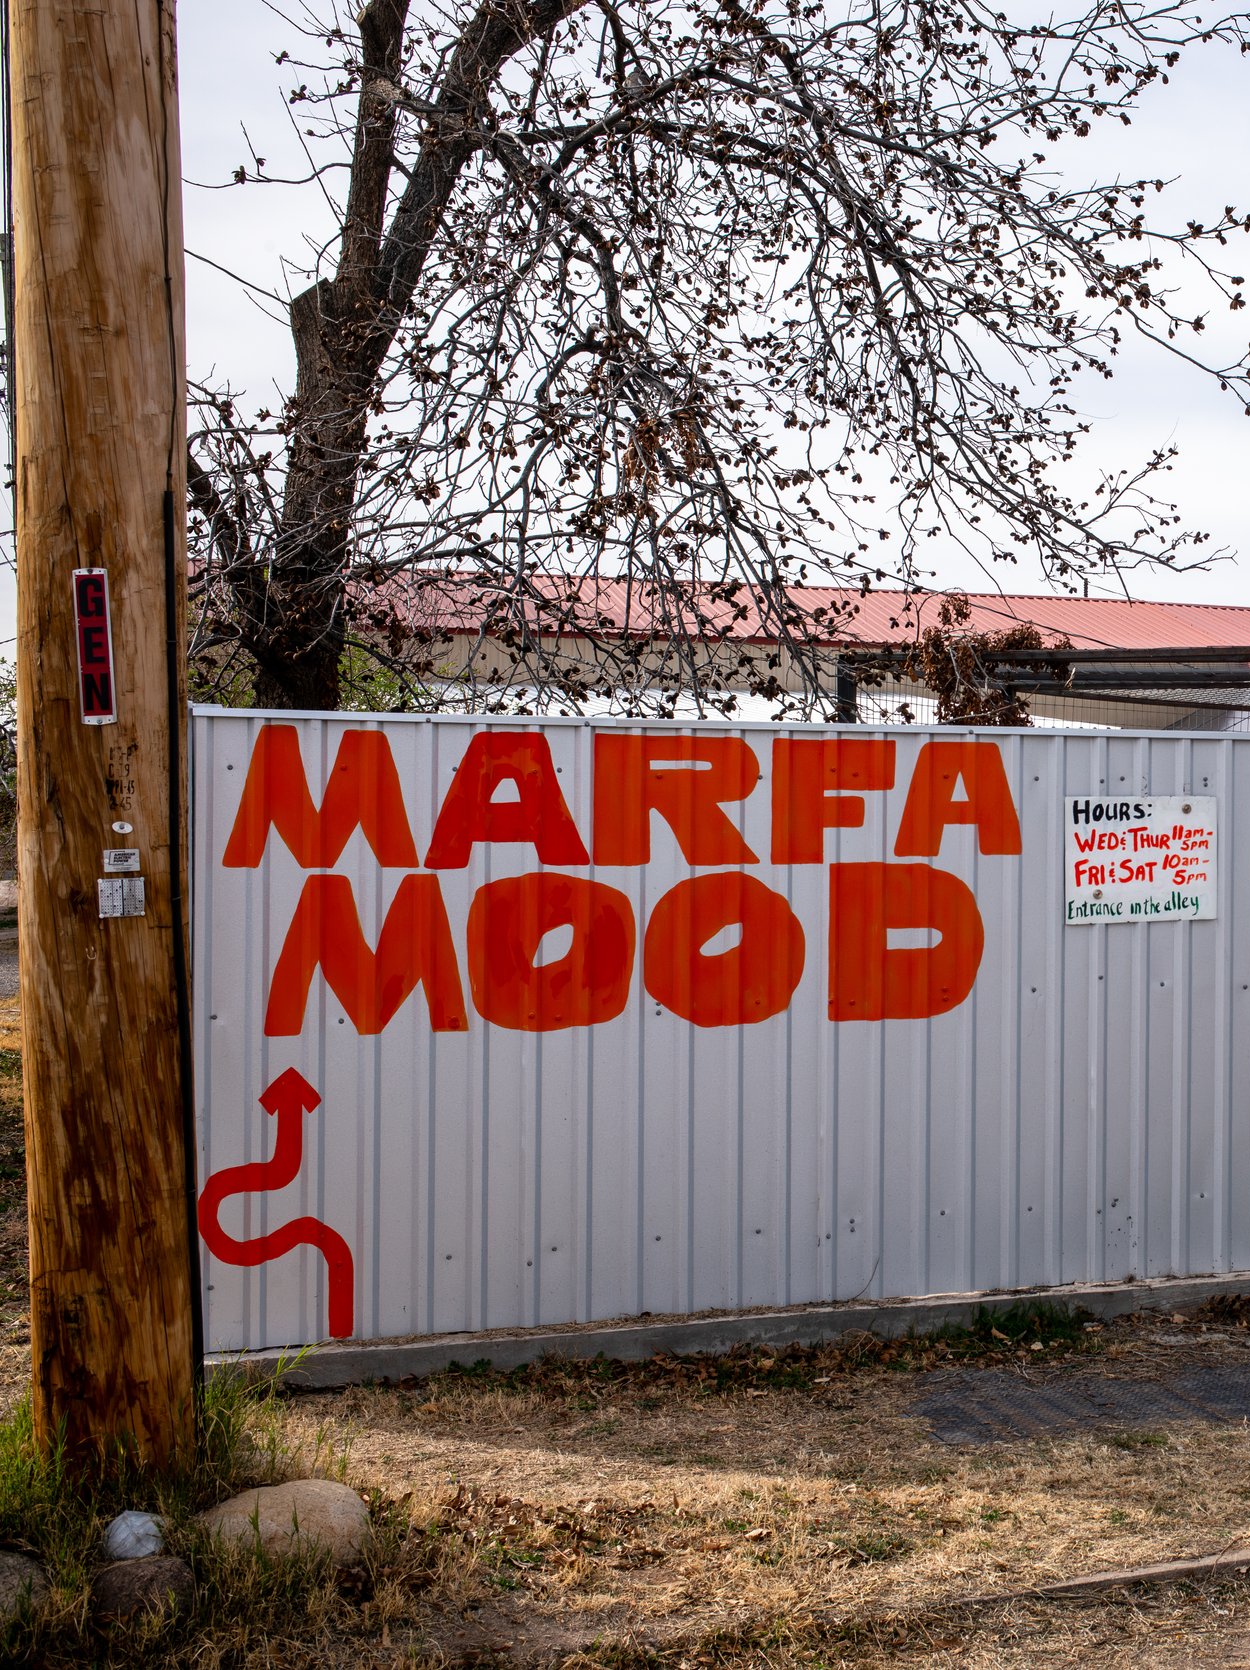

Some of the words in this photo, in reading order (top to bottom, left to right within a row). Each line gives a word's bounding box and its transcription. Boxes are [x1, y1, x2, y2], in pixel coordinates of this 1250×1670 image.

[79, 577, 111, 711] GEN
[222, 726, 1022, 869] MARFA
[1073, 800, 1153, 825] HOURS:
[1074, 828, 1119, 853] WED
[1127, 826, 1171, 853] THUR
[1180, 840, 1209, 852] 5pm
[1074, 859, 1105, 888] FRI
[1118, 859, 1158, 884] SAT
[1172, 869, 1207, 886] 5pm
[1067, 899, 1123, 920] Entrance
[1130, 902, 1143, 915] in
[1143, 896, 1161, 915] the
[1164, 891, 1200, 916] alley
[264, 862, 984, 1036] MOOD
